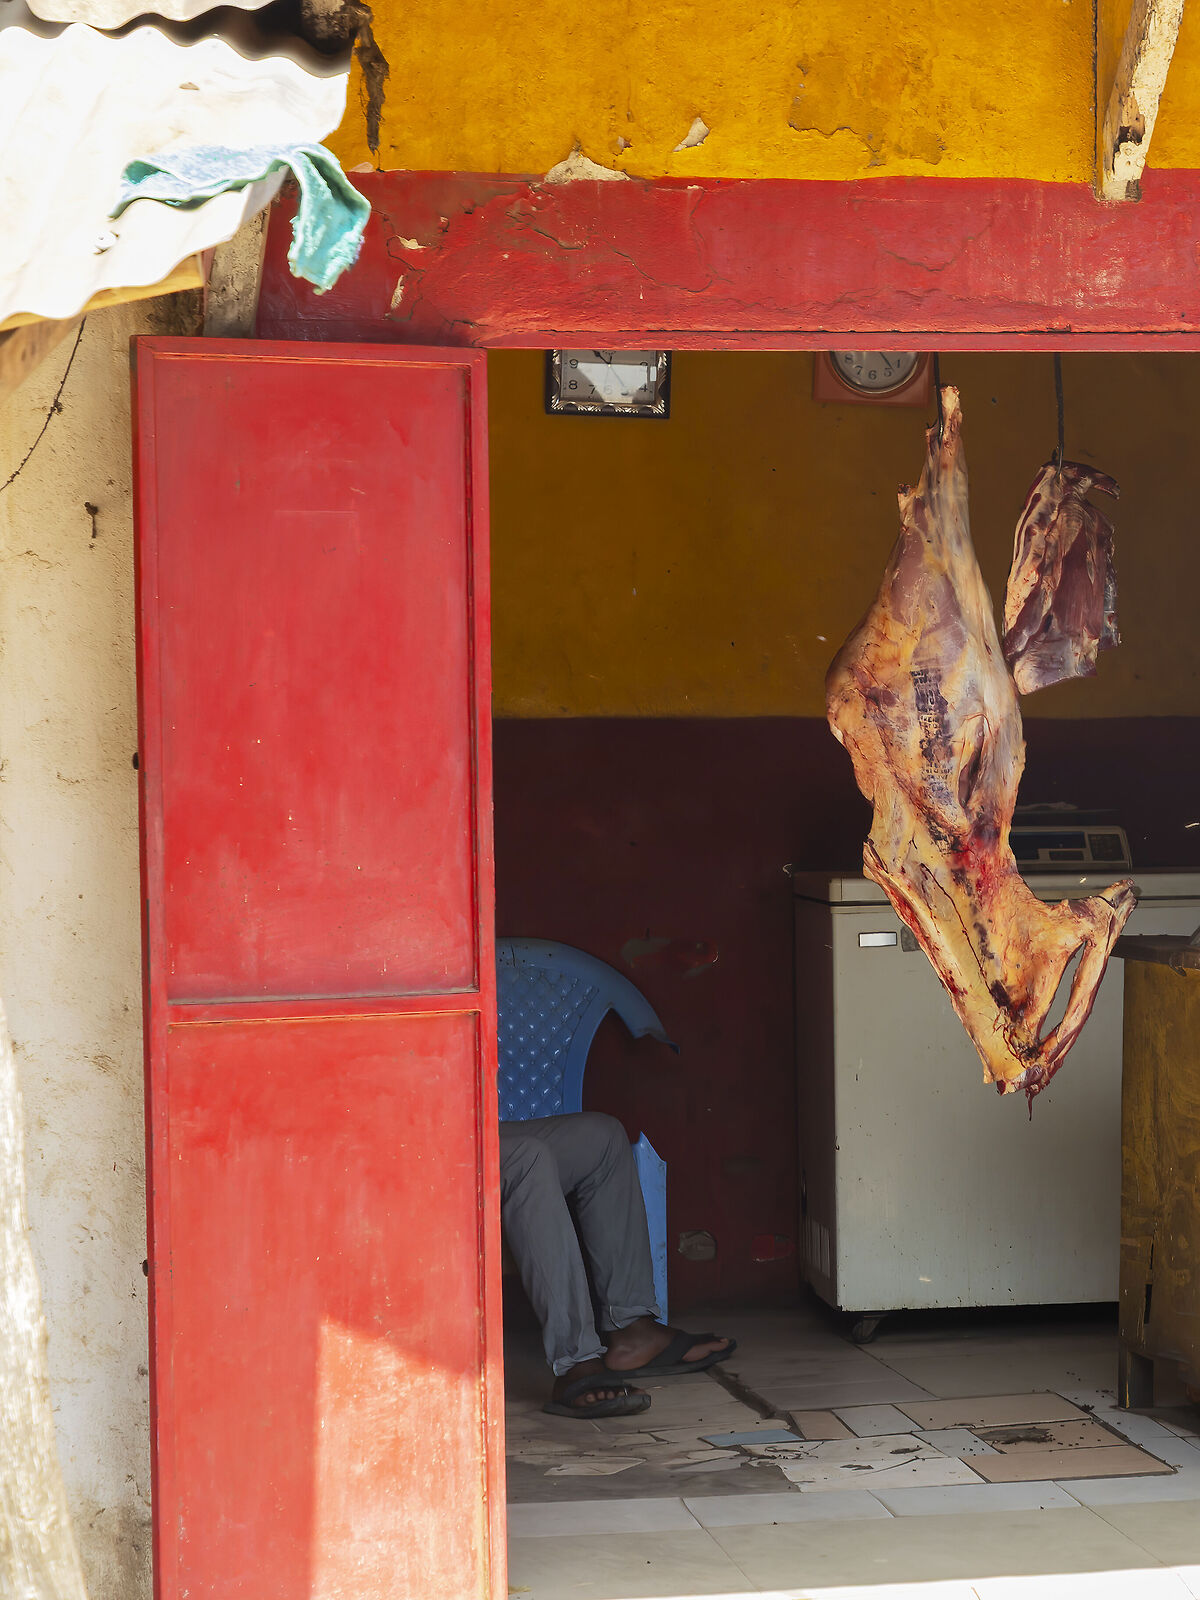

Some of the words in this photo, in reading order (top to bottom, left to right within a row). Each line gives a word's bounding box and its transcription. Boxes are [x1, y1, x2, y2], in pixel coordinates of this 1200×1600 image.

[569, 358, 579, 369] 9
[855, 365, 863, 375] 7
[868, 370, 877, 380] 6
[884, 367, 892, 377] 5
[568, 379, 578, 390] 8
[588, 384, 596, 395] 7
